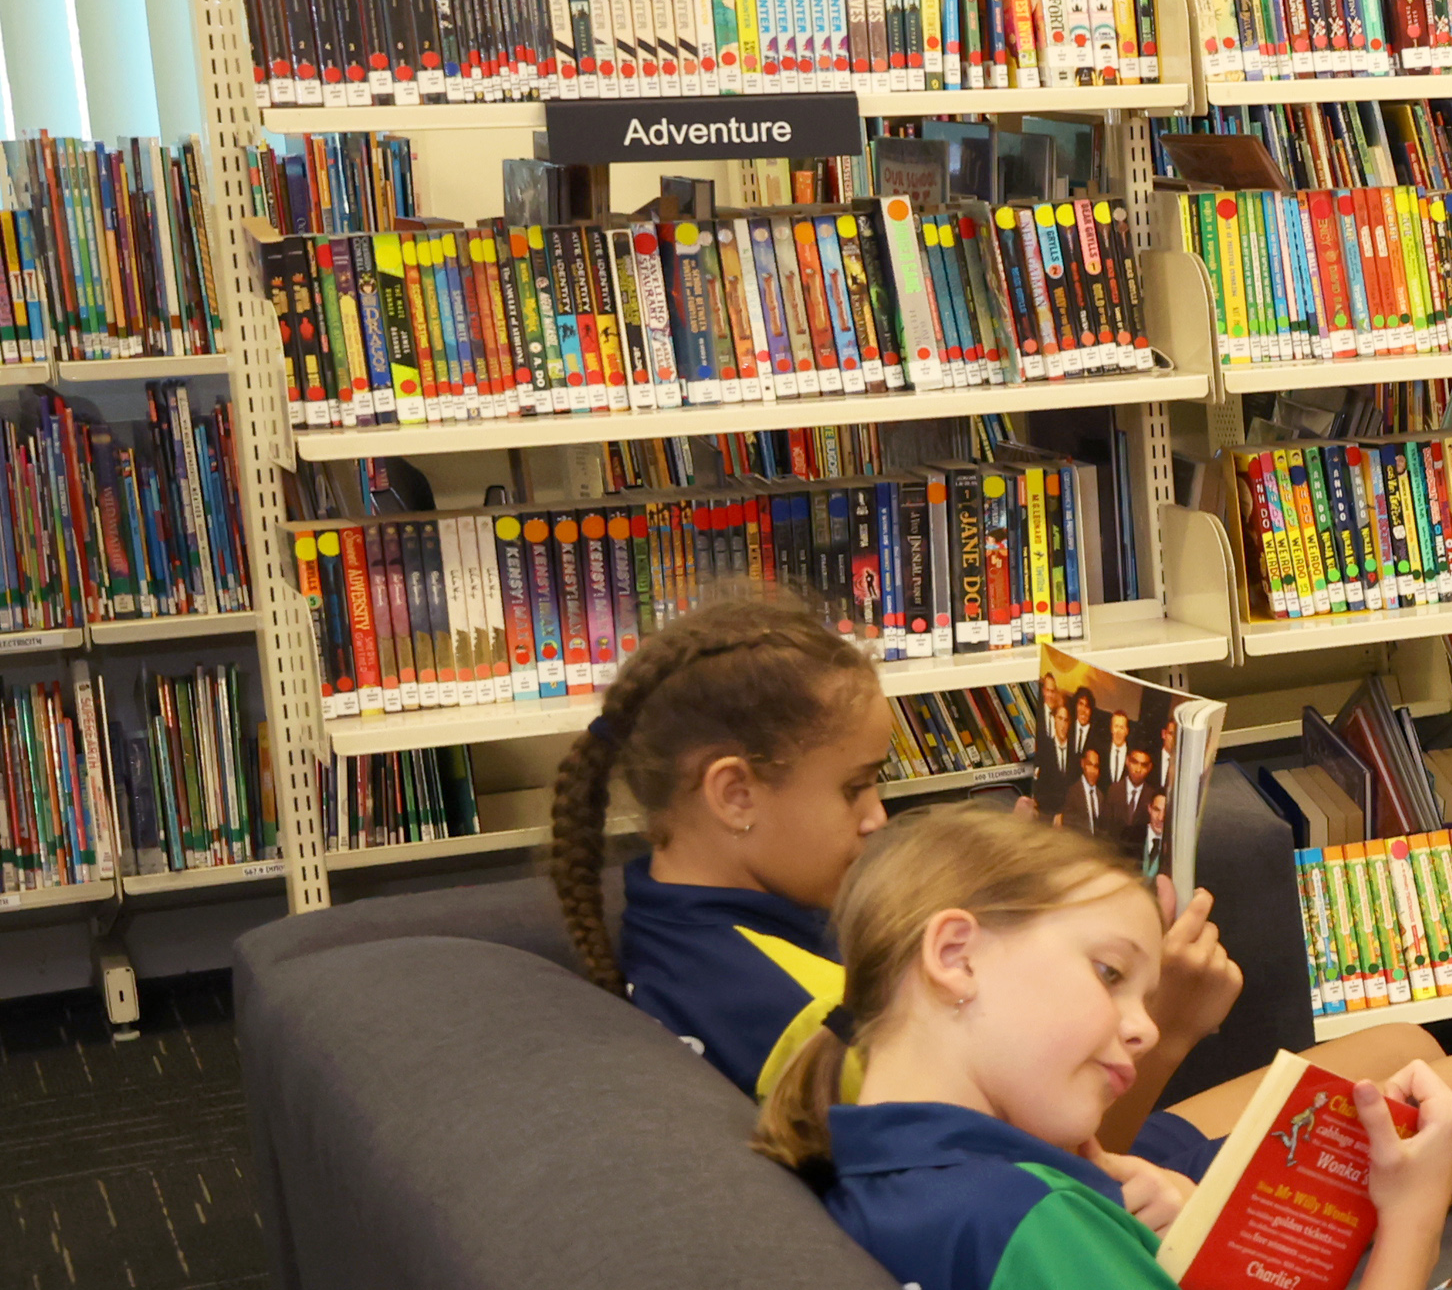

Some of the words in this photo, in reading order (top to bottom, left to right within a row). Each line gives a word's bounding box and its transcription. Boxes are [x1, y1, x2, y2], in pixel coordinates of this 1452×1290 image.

[624, 116, 792, 147] Adventure
[348, 569, 369, 630] ADVERSITY
[1293, 1191, 1321, 1214] Willy
[1324, 1201, 1359, 1228] Wonka
